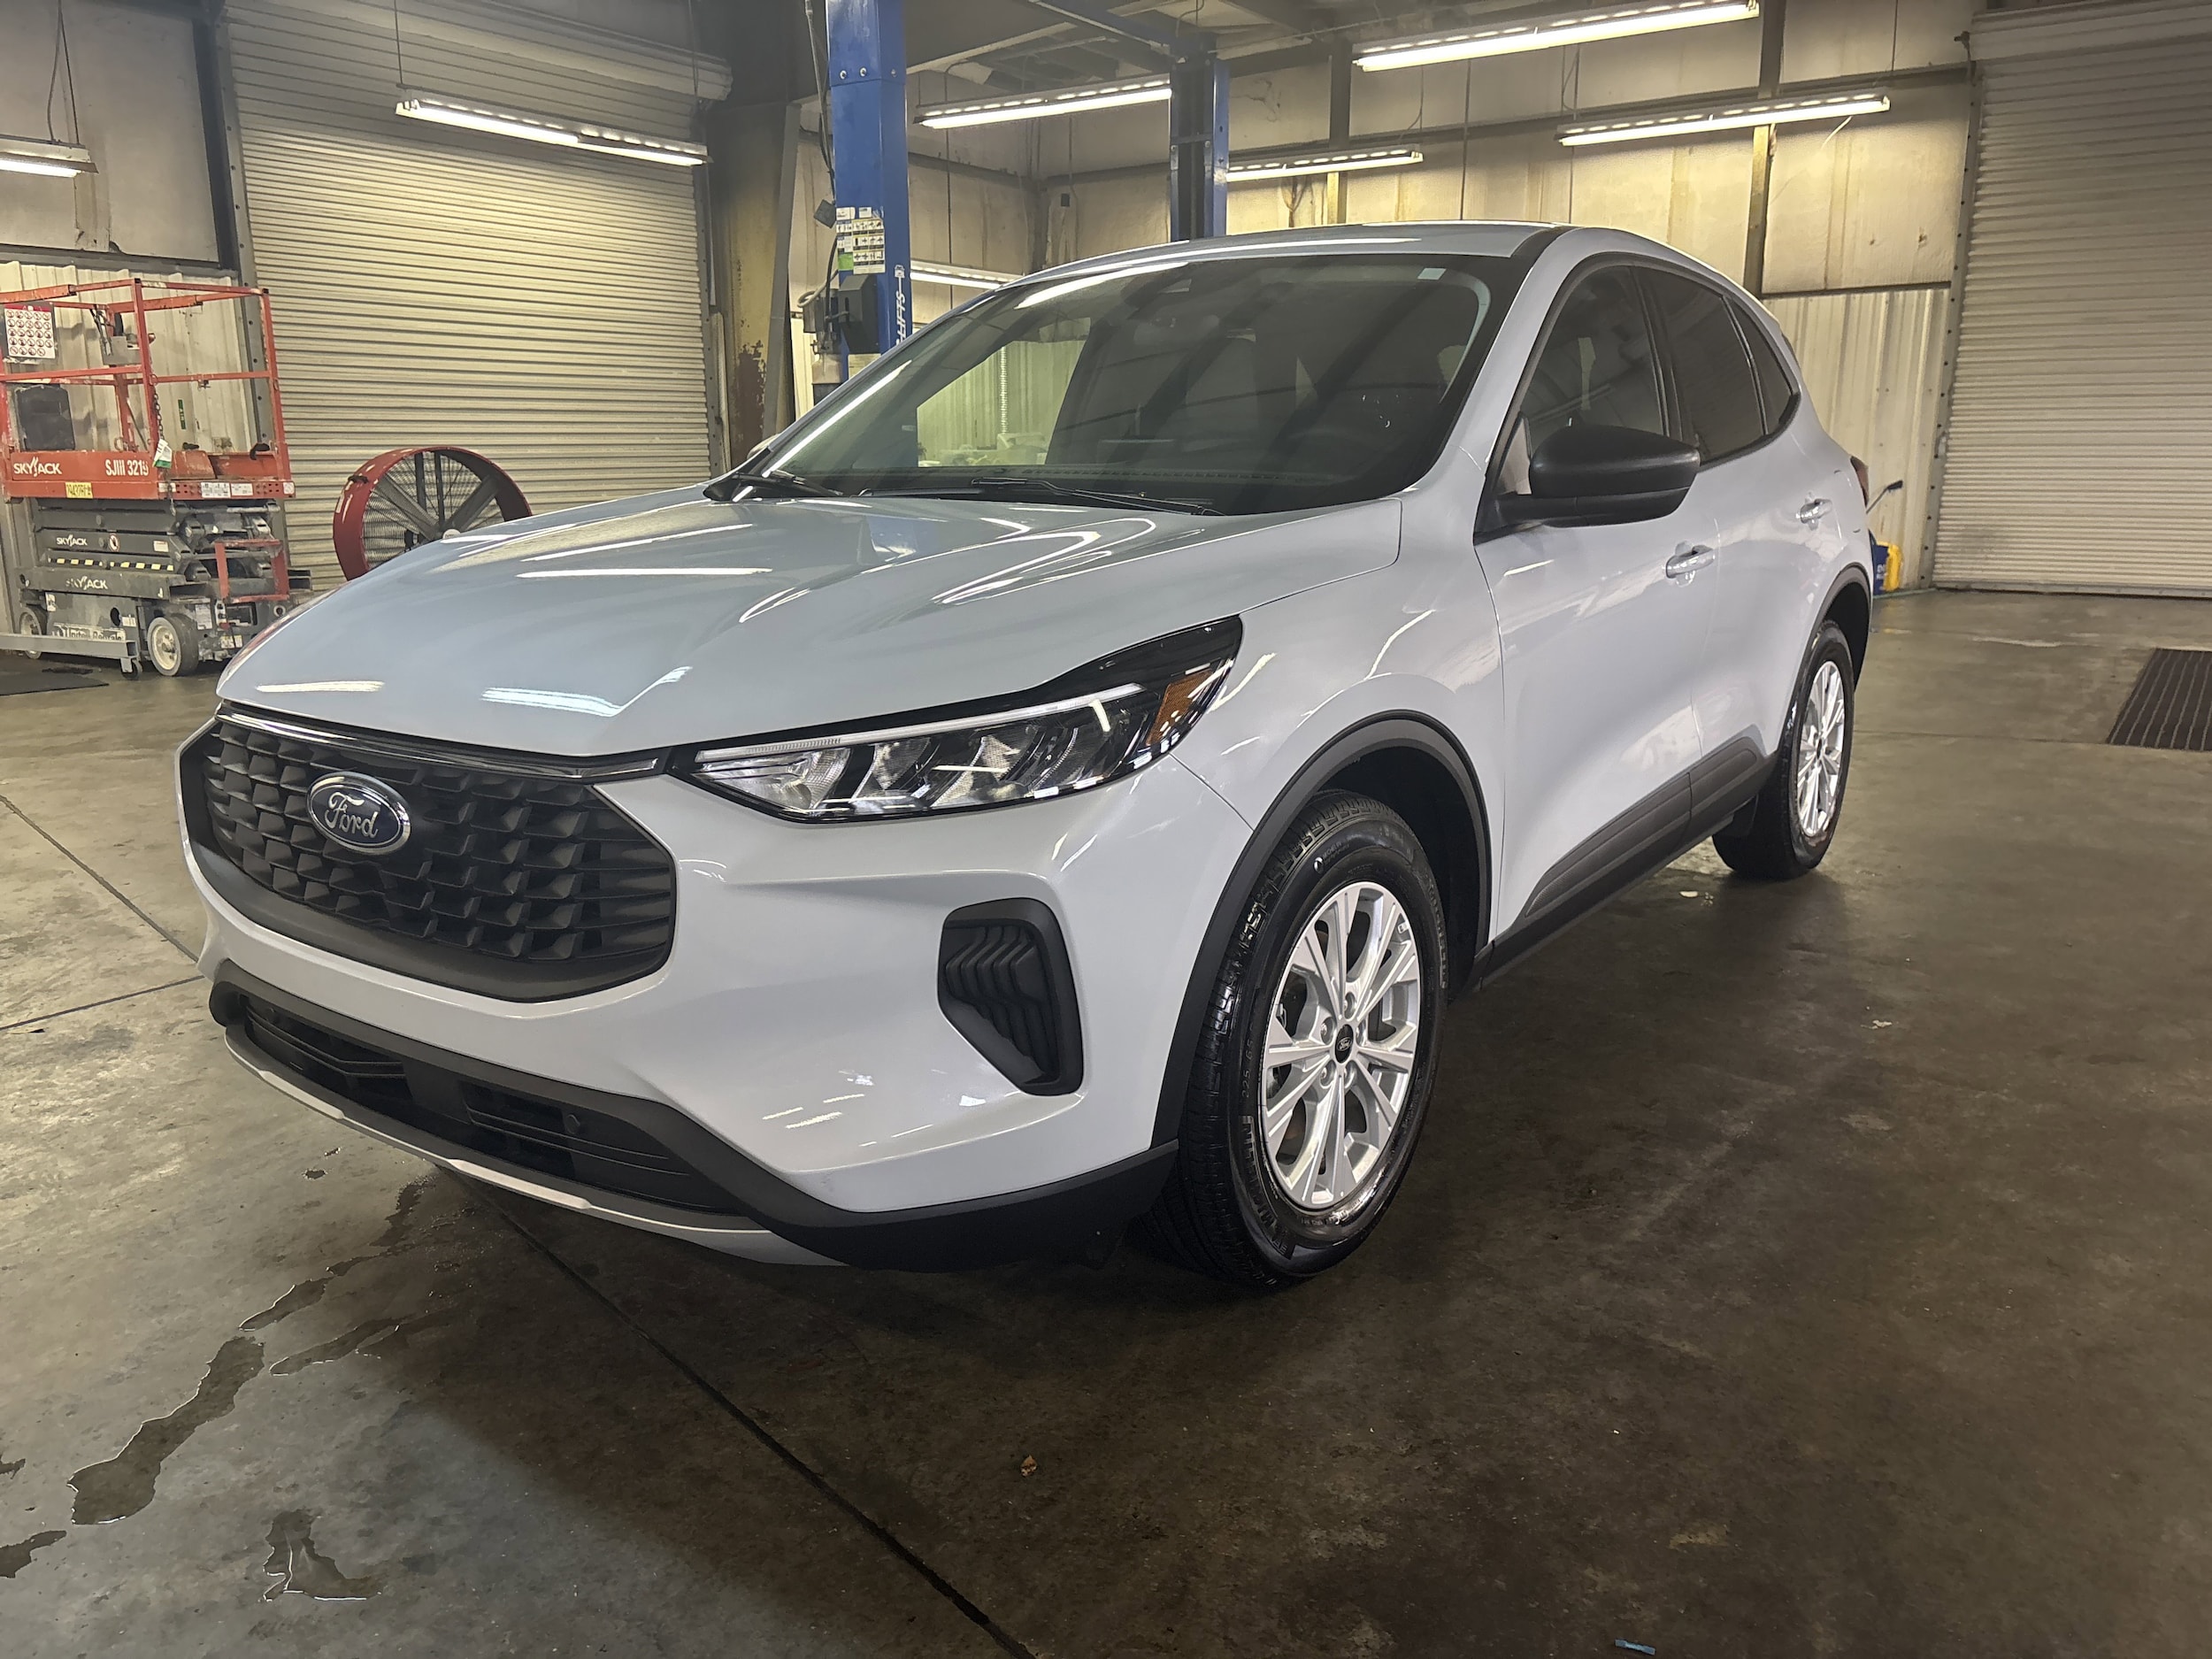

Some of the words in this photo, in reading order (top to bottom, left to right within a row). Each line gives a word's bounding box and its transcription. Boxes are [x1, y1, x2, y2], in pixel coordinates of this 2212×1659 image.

[13, 456, 62, 477] SKYJACK
[57, 534, 88, 547] SKYJACK
[324, 791, 379, 839] Ford
